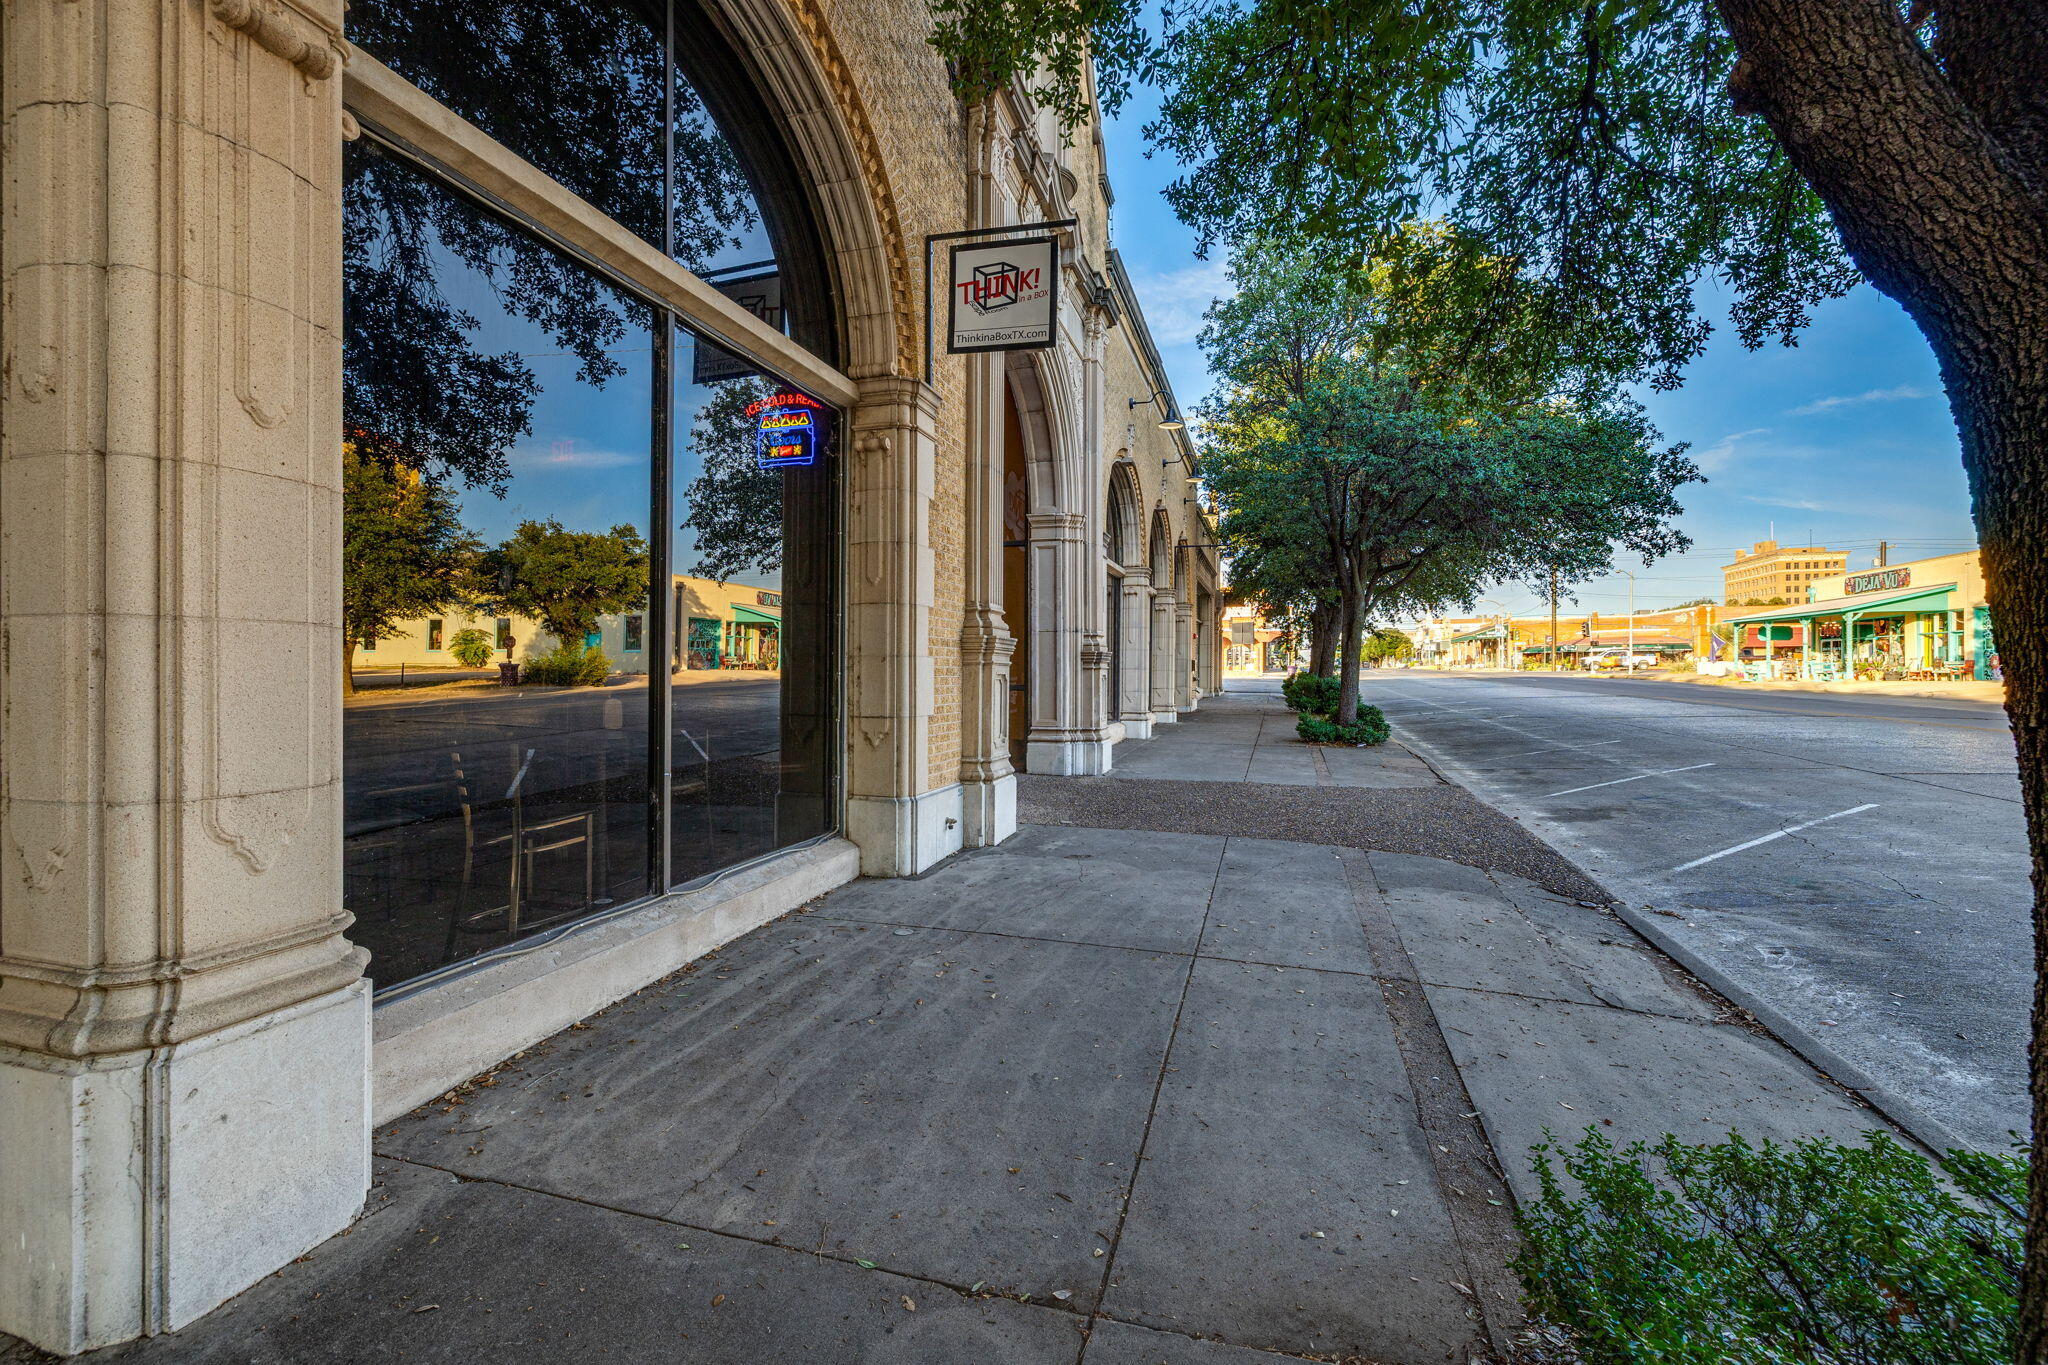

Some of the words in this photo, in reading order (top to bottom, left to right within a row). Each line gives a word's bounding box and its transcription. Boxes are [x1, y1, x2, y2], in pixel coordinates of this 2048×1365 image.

[957, 268, 1040, 305] THINK!
[1034, 289, 1049, 300] BOX
[955, 330, 1047, 344] ThinkinaBoxTX.com
[745, 401, 762, 417] ICE
[787, 394, 795, 405] &
[769, 434, 801, 447] Coors
